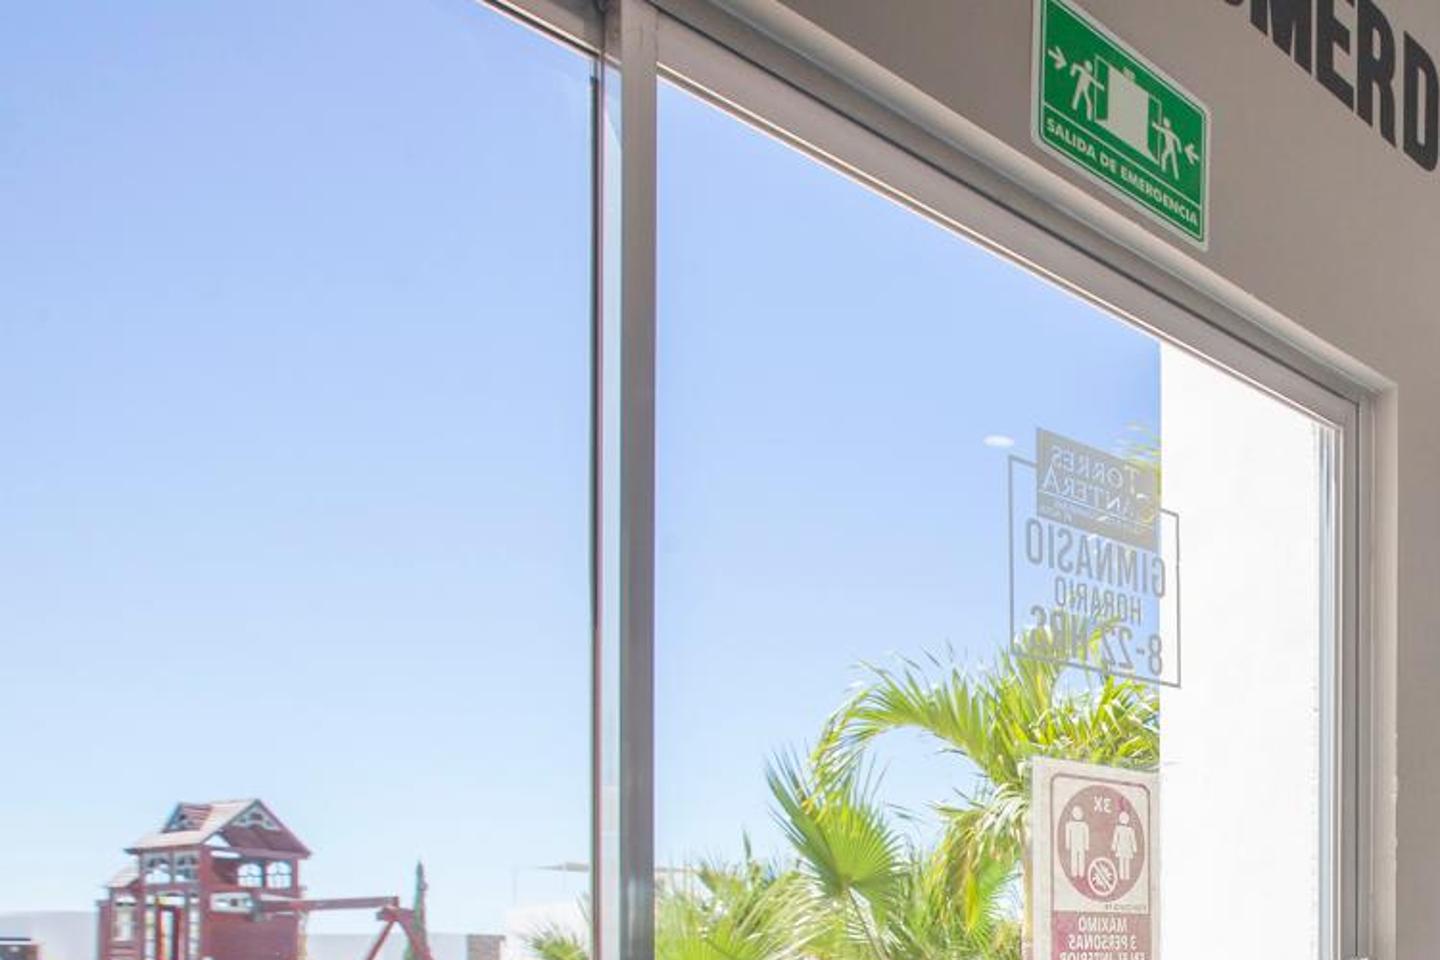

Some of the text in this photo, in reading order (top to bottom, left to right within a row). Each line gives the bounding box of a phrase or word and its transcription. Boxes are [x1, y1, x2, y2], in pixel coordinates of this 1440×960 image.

[1047, 118, 1199, 225] SALIDA DE EMERGENCIA
